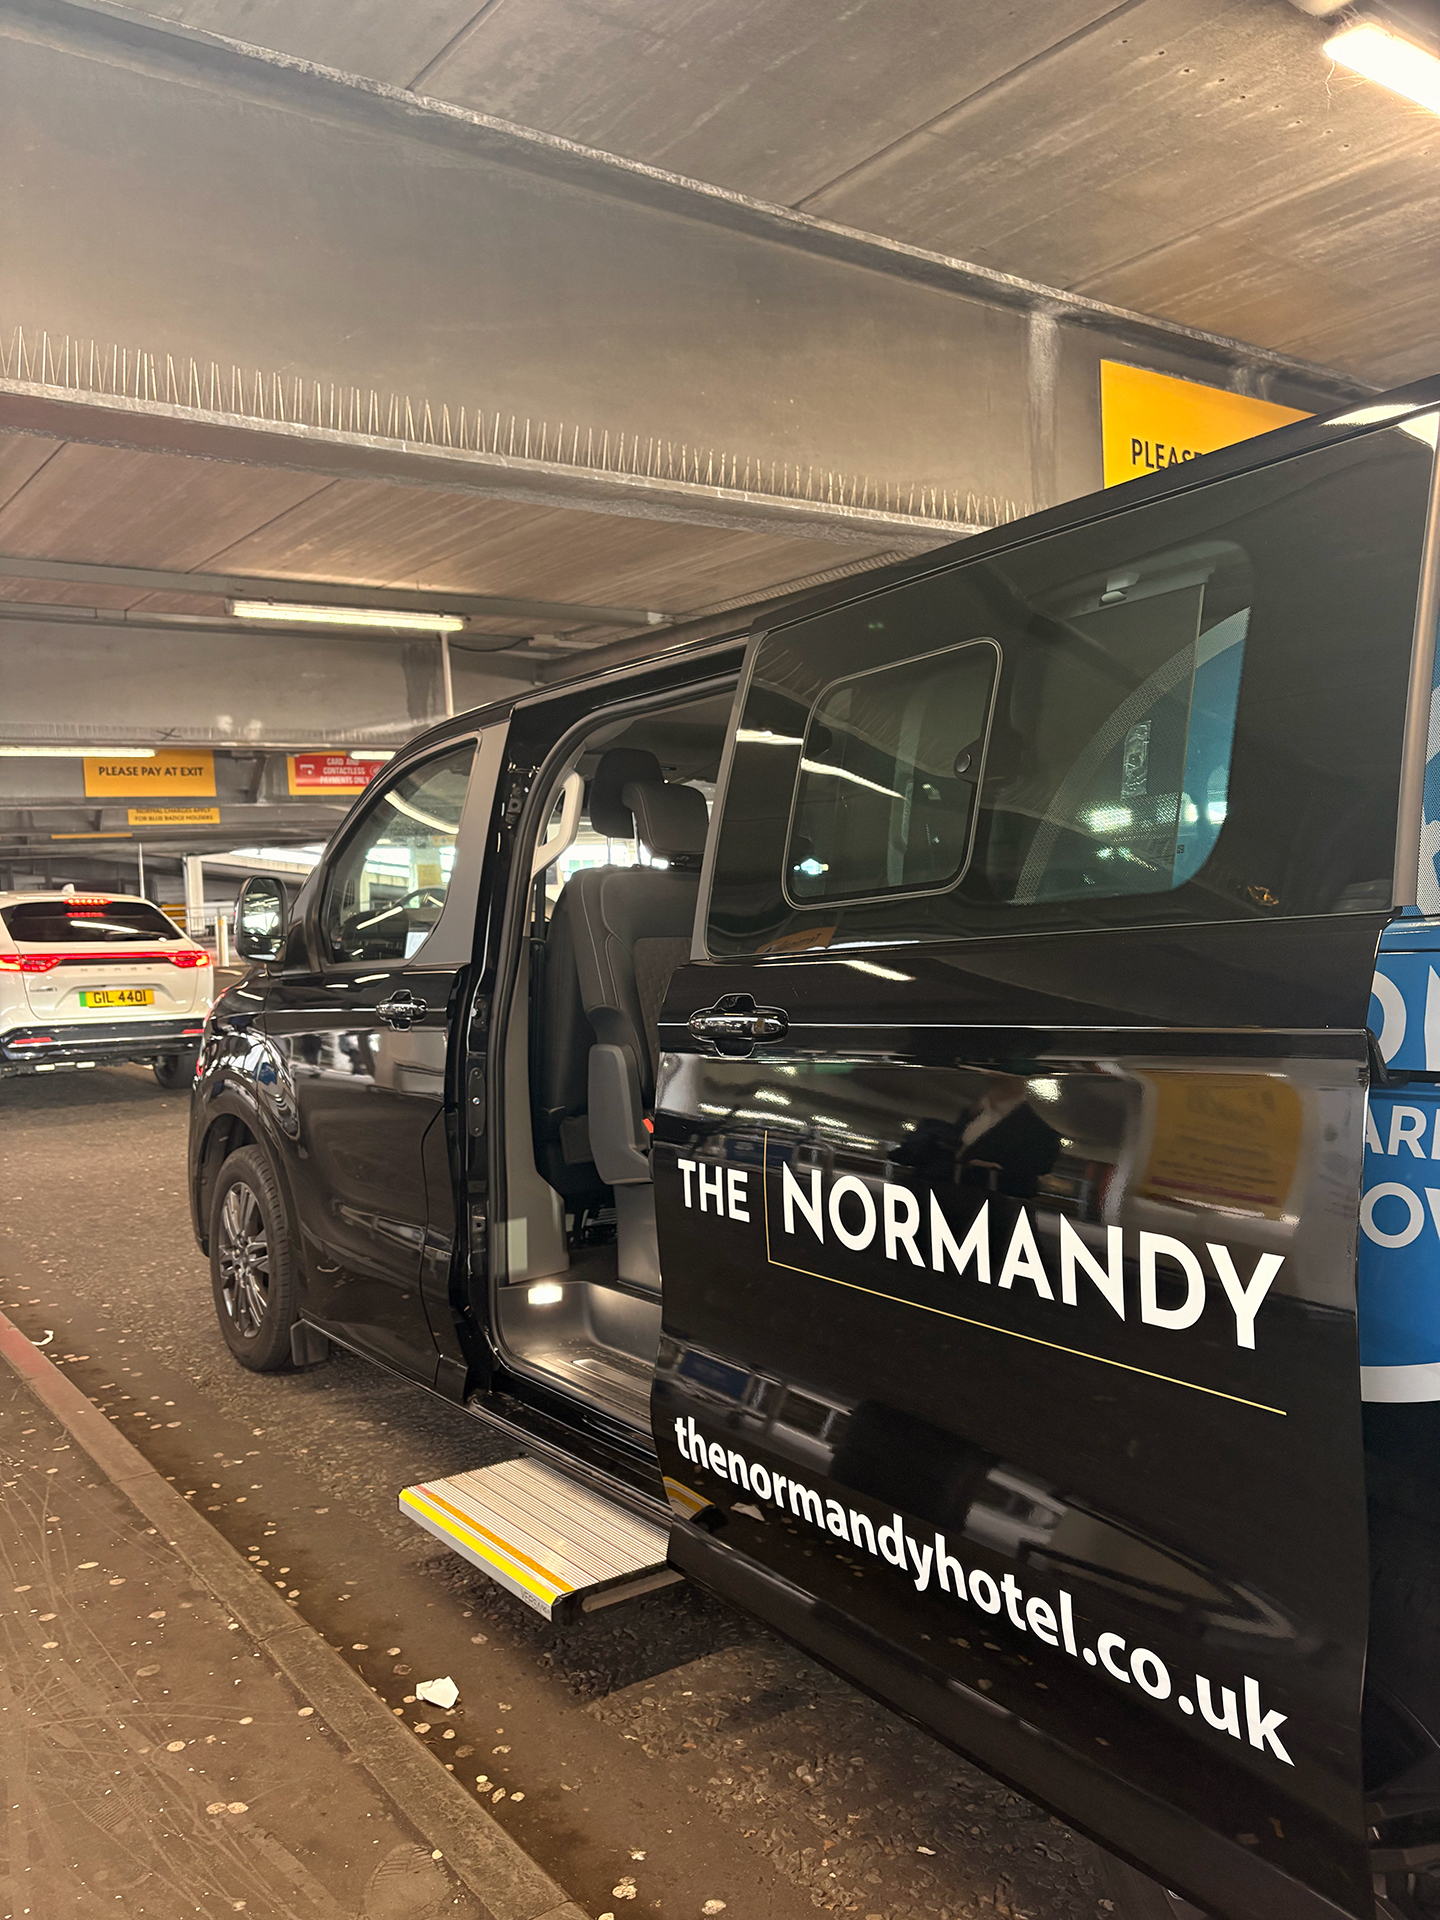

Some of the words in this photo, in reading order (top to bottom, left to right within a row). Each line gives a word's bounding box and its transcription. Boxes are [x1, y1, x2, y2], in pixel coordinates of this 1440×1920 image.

[1131, 437, 1203, 470] PLEA
[98, 766, 139, 776] PLEASE
[141, 766, 162, 776] PAY
[164, 767, 178, 776] AT
[180, 767, 204, 776] EXIT
[323, 766, 366, 775] CONTACTLESS
[320, 776, 353, 785] PAYMENTS
[354, 776, 370, 785] ONLY
[93, 992, 114, 1004] GIL
[118, 990, 147, 1003] 4401
[677, 1158, 751, 1224] THE
[781, 1160, 1286, 1350] NORMANDY
[674, 1416, 1296, 1767] thenormandyhotel.co.uk
